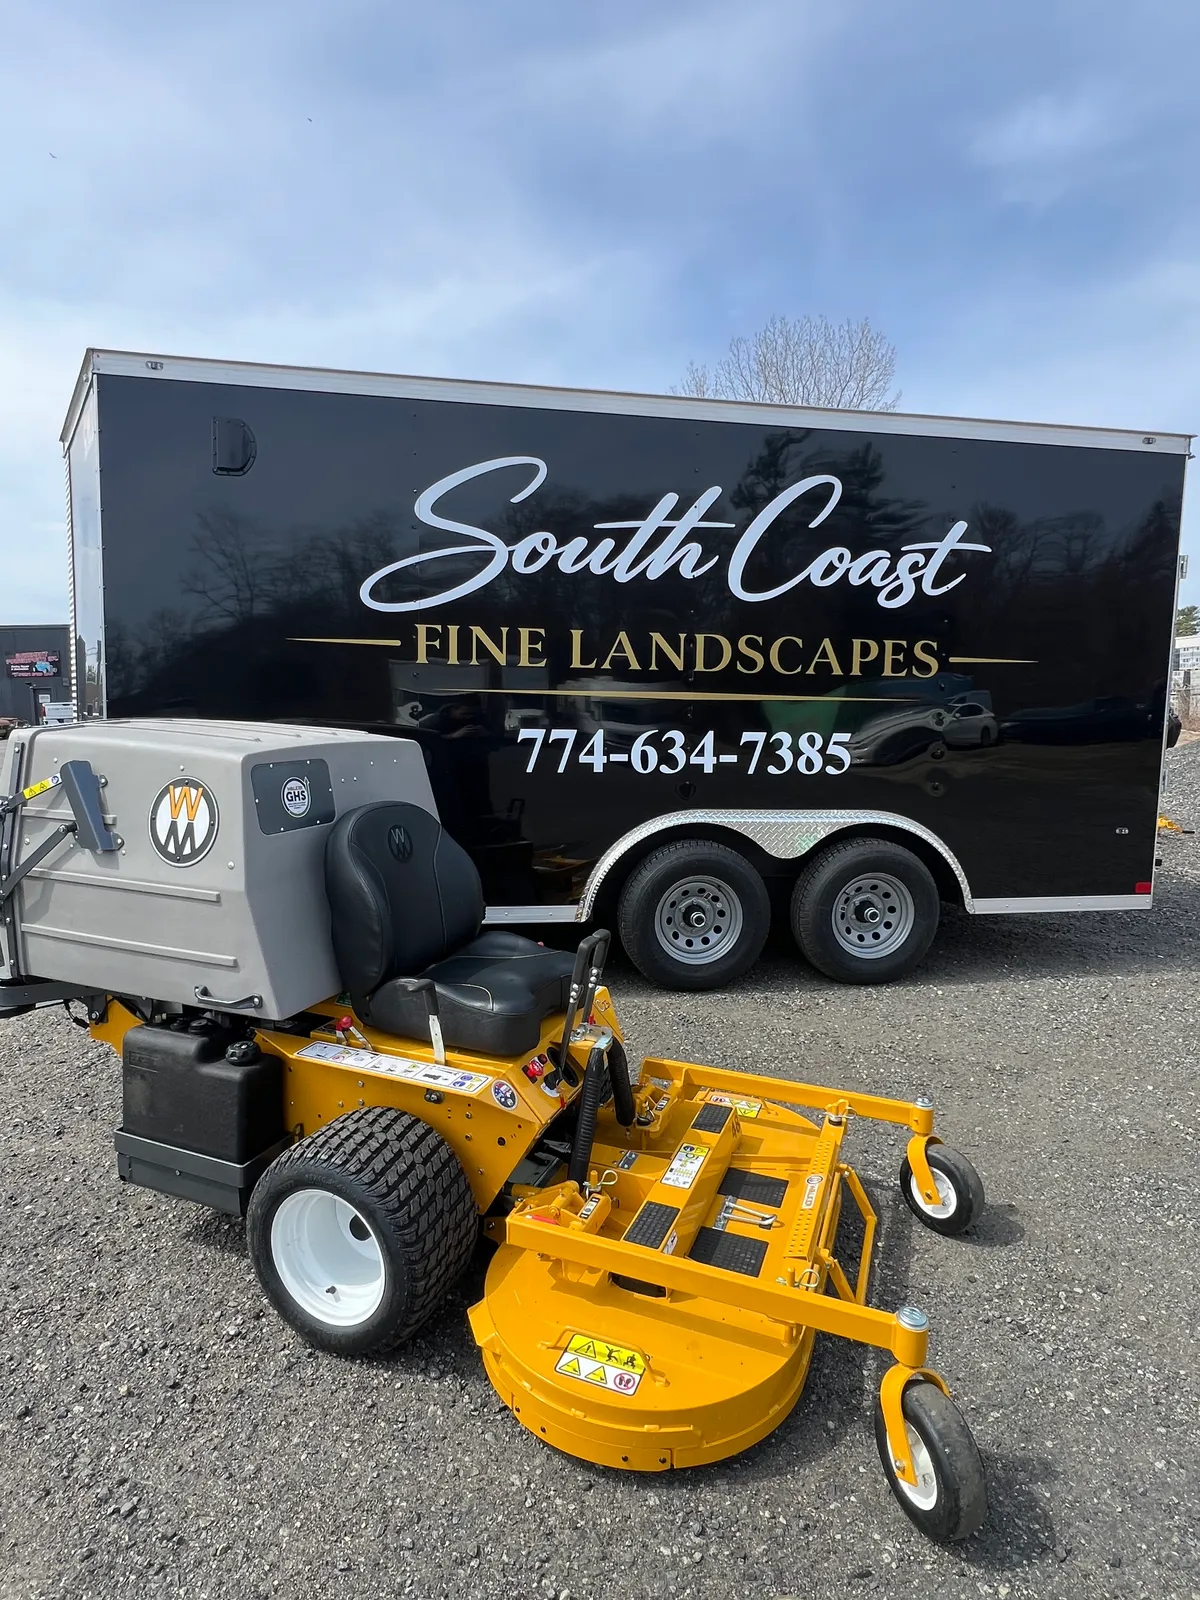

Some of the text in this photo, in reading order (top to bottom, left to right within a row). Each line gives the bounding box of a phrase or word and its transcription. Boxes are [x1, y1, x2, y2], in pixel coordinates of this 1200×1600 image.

[359, 456, 993, 613] South Coast
[414, 623, 940, 678] FINE LANDSCAPES
[517, 728, 853, 775] 774-634-7385
[285, 790, 307, 802] GHS
